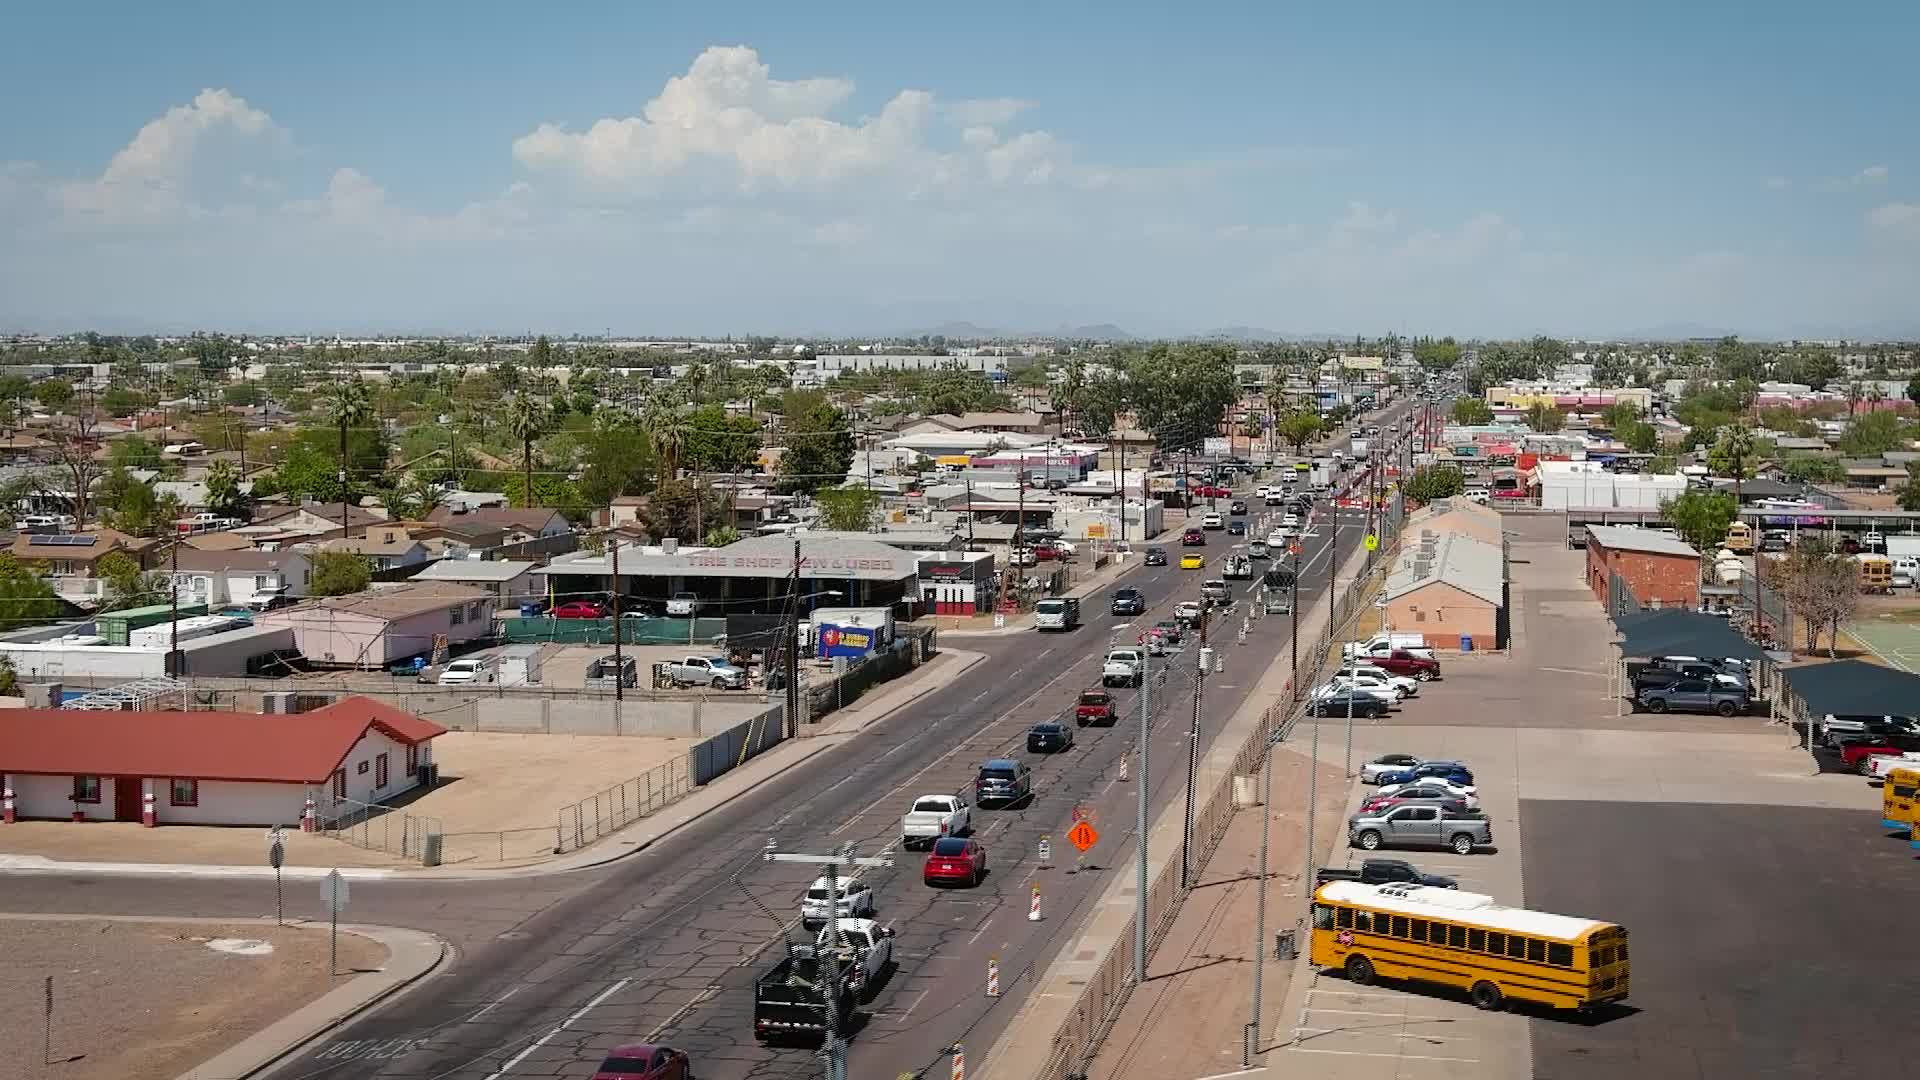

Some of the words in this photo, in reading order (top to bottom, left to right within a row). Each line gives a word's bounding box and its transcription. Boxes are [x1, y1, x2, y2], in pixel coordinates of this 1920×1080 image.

[686, 556, 727, 567] TIRE
[734, 556, 782, 569] SHOP
[846, 558, 895, 571] USED
